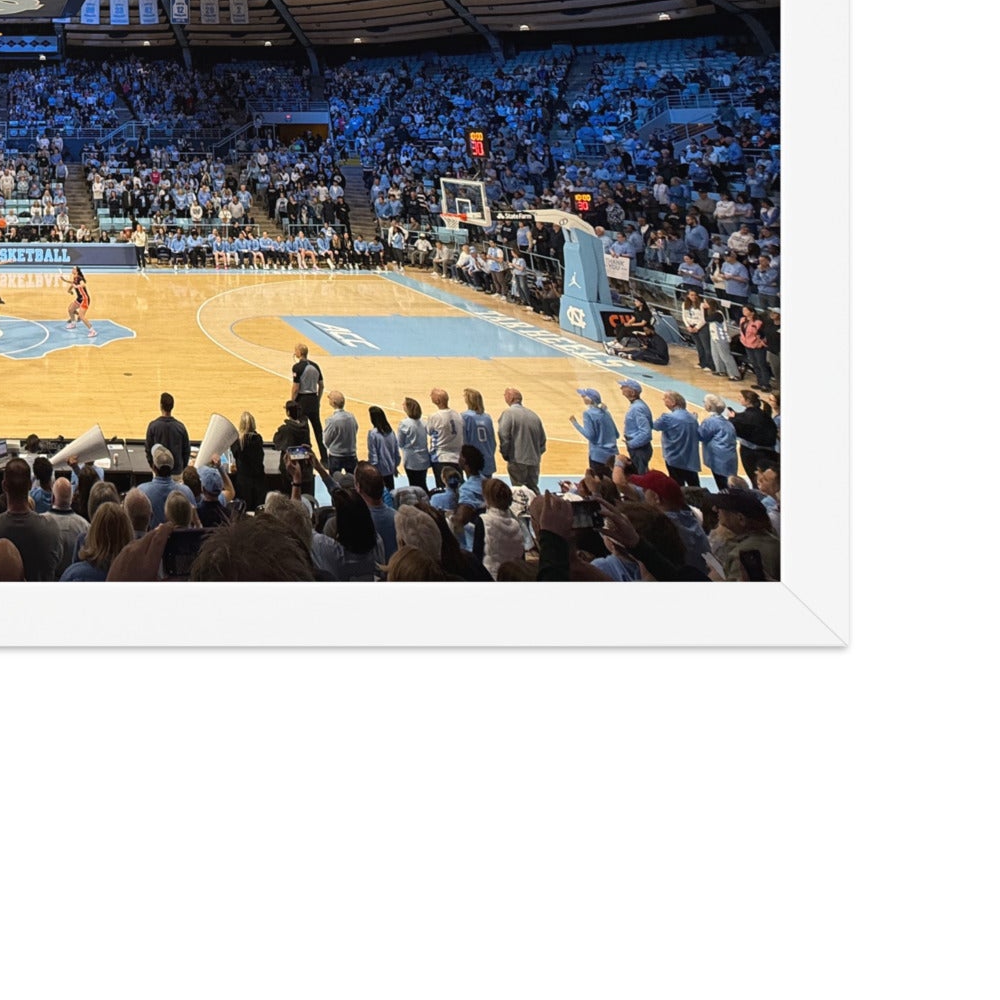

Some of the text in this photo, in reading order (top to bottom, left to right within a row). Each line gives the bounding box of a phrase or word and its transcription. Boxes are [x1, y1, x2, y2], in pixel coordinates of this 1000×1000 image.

[470, 141, 485, 156] 30
[577, 202, 589, 210] 30
[477, 426, 487, 442] 0
